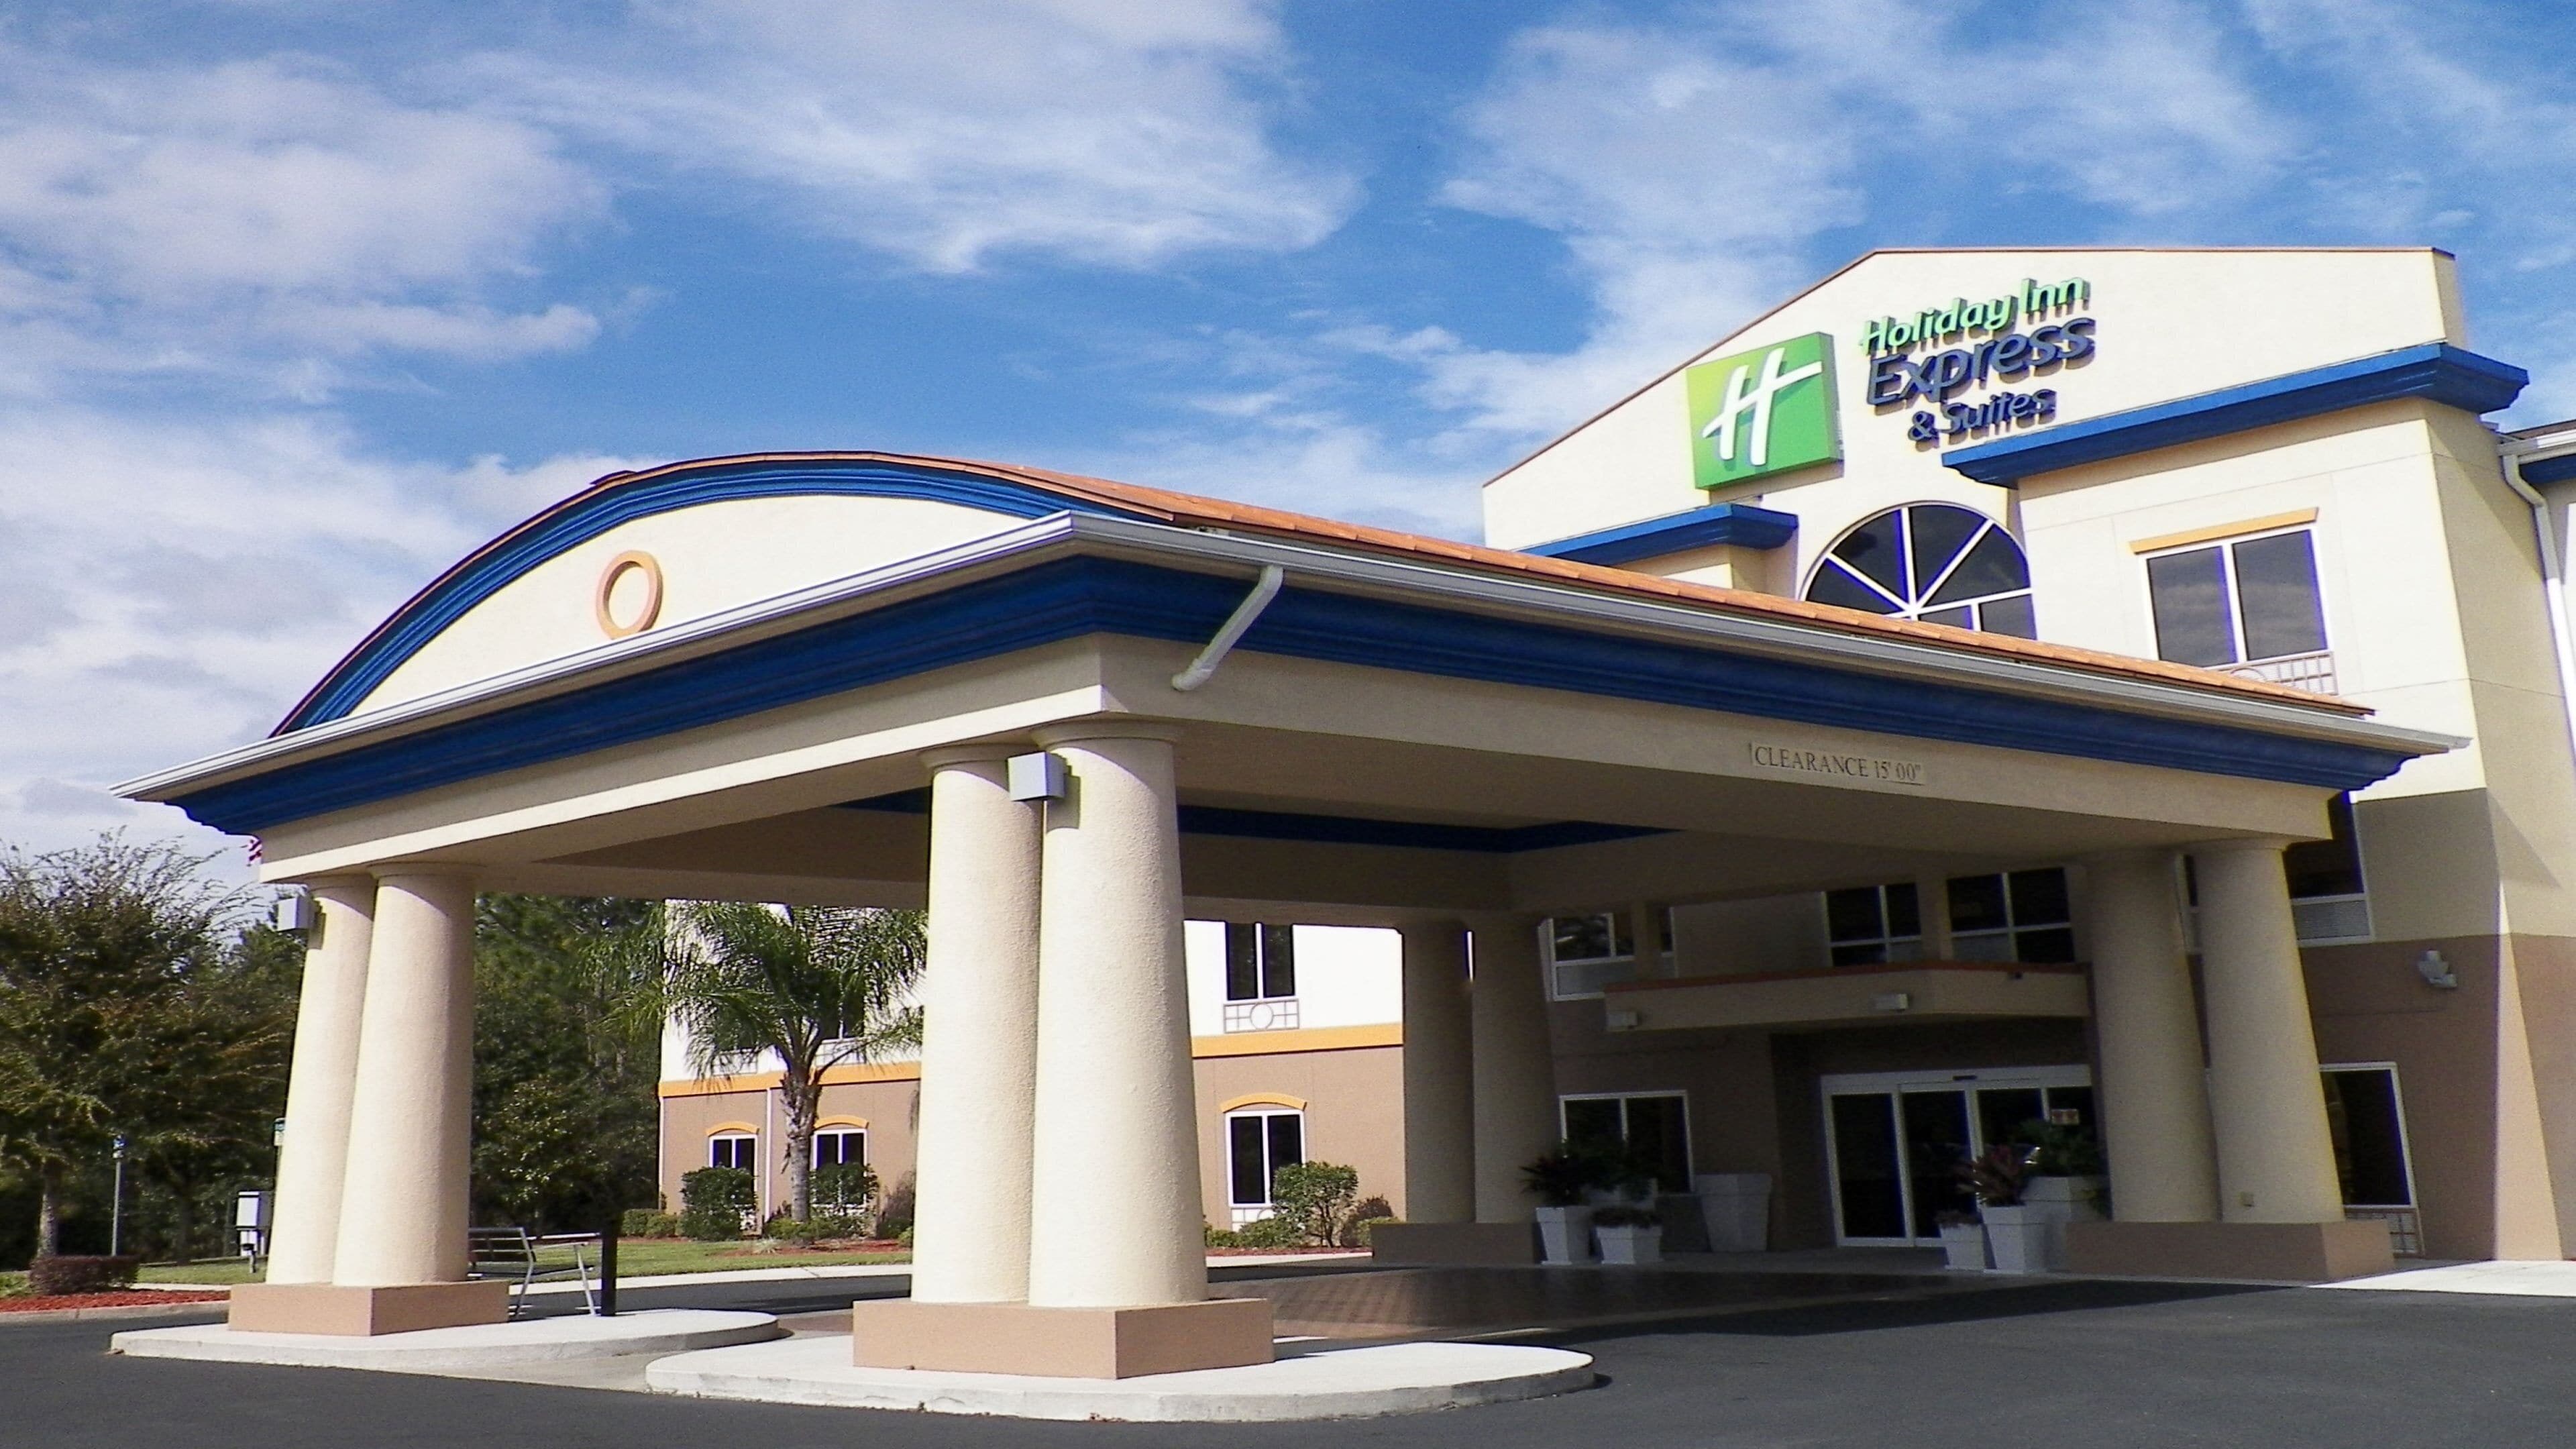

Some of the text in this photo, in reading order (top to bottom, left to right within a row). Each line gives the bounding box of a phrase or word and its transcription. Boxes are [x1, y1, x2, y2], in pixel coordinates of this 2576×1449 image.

[1860, 278, 2092, 354] Holiday Inn
[1866, 317, 2096, 405] Express
[1908, 388, 2057, 442] & Suites
[1755, 746, 1869, 777] CLEARANCE
